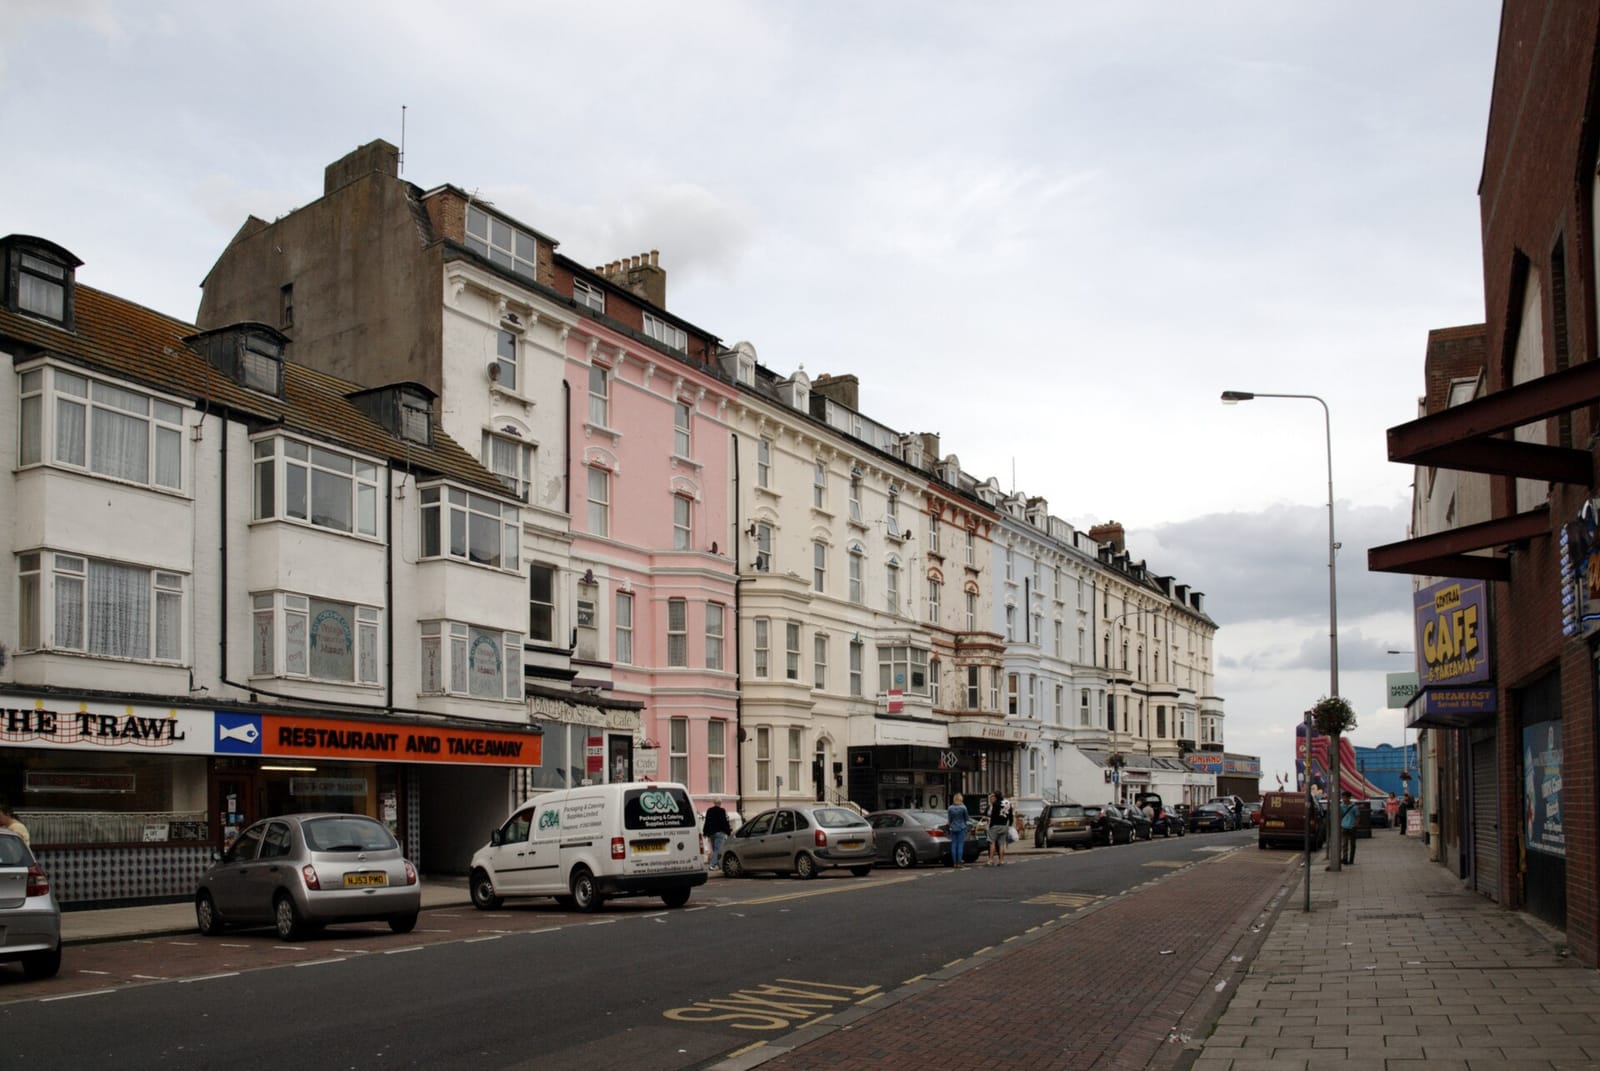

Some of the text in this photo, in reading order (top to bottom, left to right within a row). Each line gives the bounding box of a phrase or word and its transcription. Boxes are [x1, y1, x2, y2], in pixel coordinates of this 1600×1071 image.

[1436, 589, 1459, 608] CENTRAL
[1424, 604, 1478, 664] CAFE
[1435, 658, 1477, 680] TAKEAWAY
[1431, 691, 1490, 701] BREAKFAST
[76, 712, 184, 740] TRAWL
[279, 726, 524, 757] RESTAURANT AND TAKEAWAY
